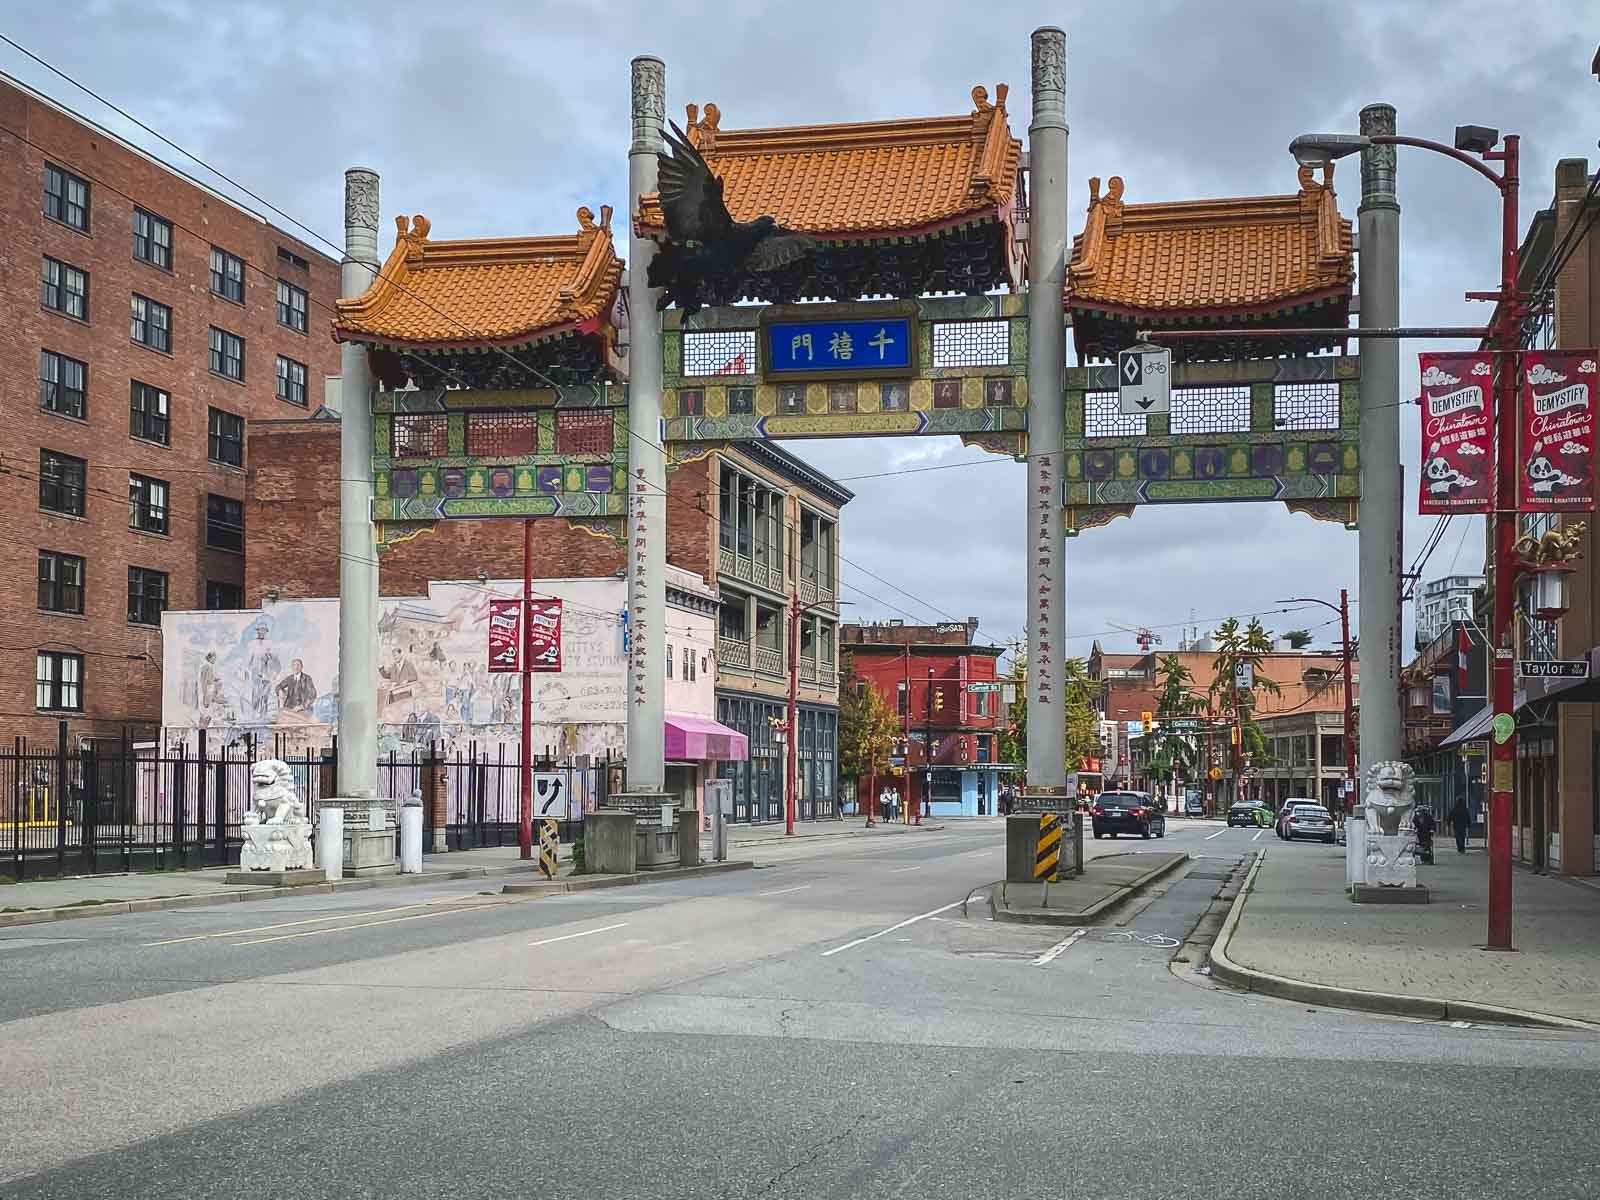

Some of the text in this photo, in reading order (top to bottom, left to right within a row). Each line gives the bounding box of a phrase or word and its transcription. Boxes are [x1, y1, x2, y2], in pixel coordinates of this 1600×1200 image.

[1432, 389, 1478, 414] DEMYSTIFY
[1536, 387, 1584, 412] DEMYSTIFY
[1427, 413, 1488, 437] Chinatown
[1531, 411, 1592, 436] Chinatown
[1525, 662, 1563, 675] Taylor
